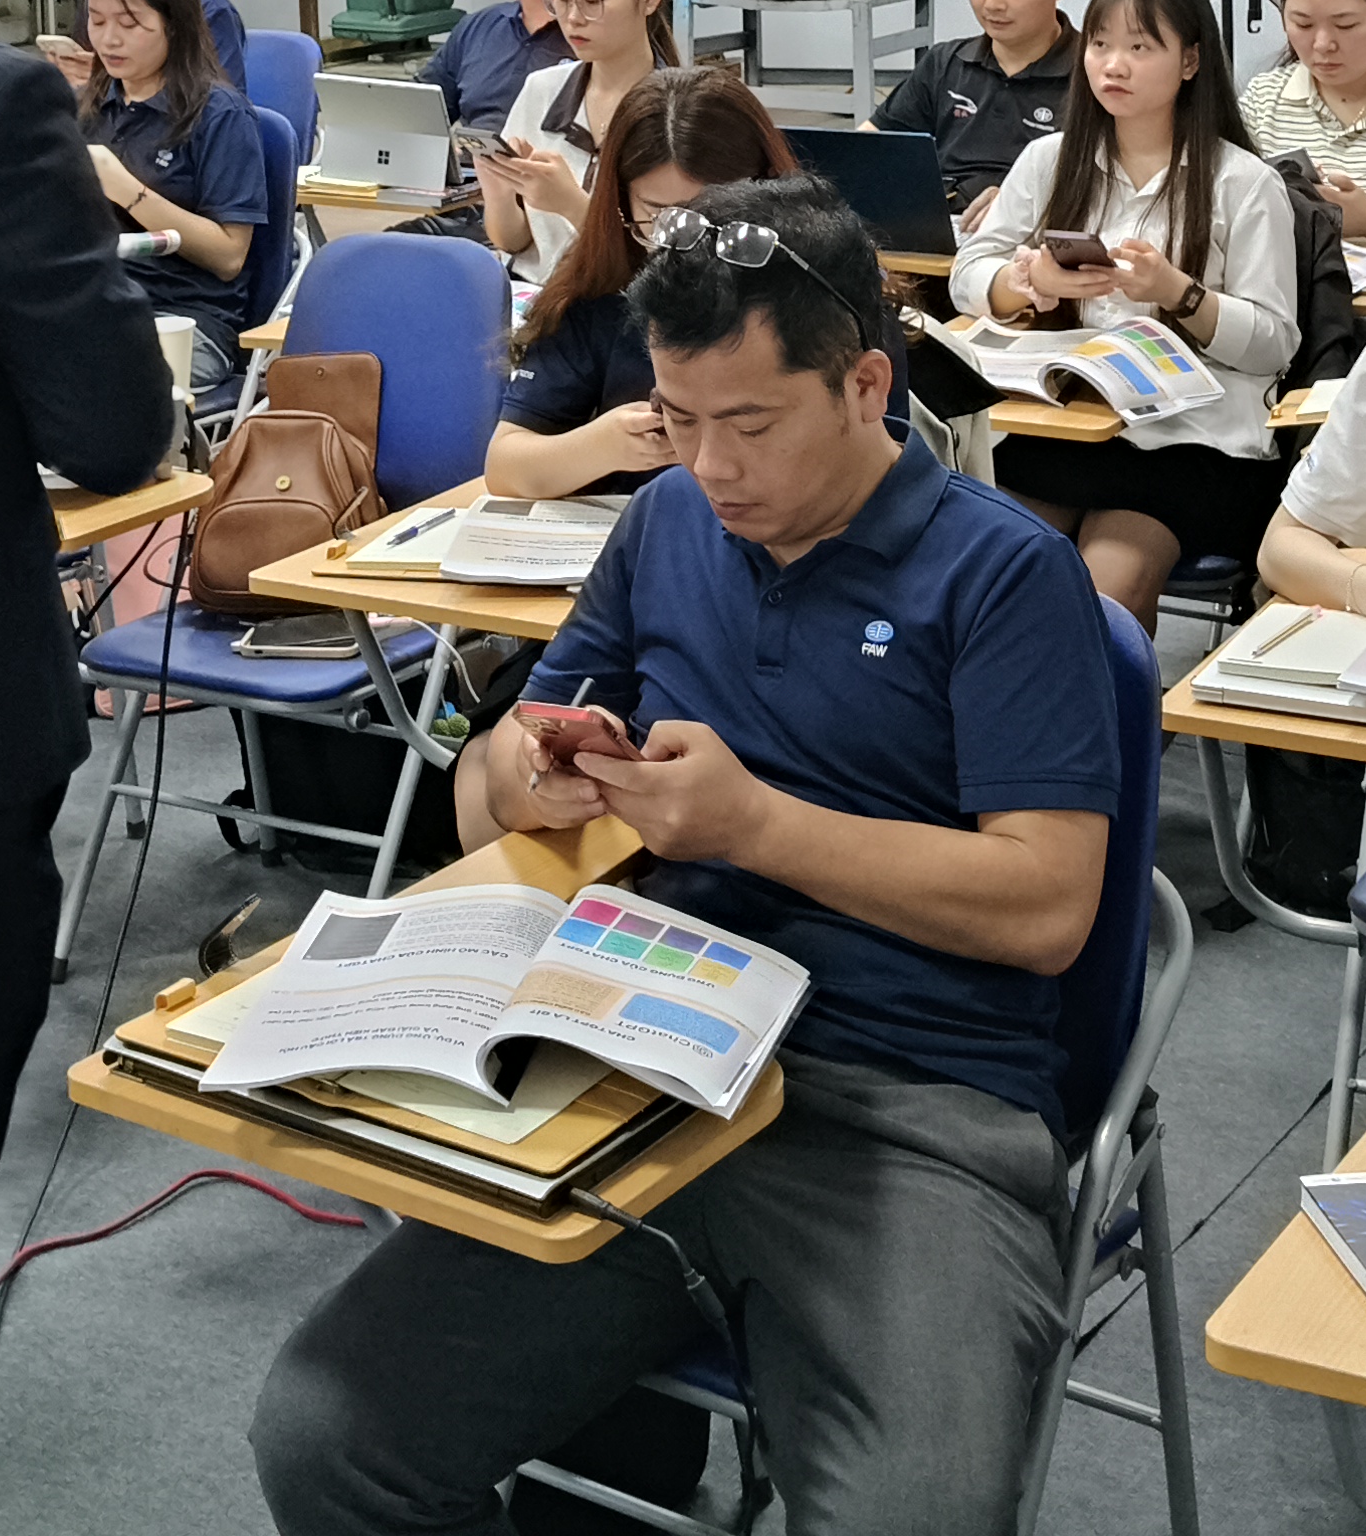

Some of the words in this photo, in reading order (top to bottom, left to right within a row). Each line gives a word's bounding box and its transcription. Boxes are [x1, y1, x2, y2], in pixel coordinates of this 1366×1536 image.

[861, 642, 888, 658] FAW
[571, 1017, 635, 1042] CHATGPT
[615, 1019, 691, 1047] ChatGPT
